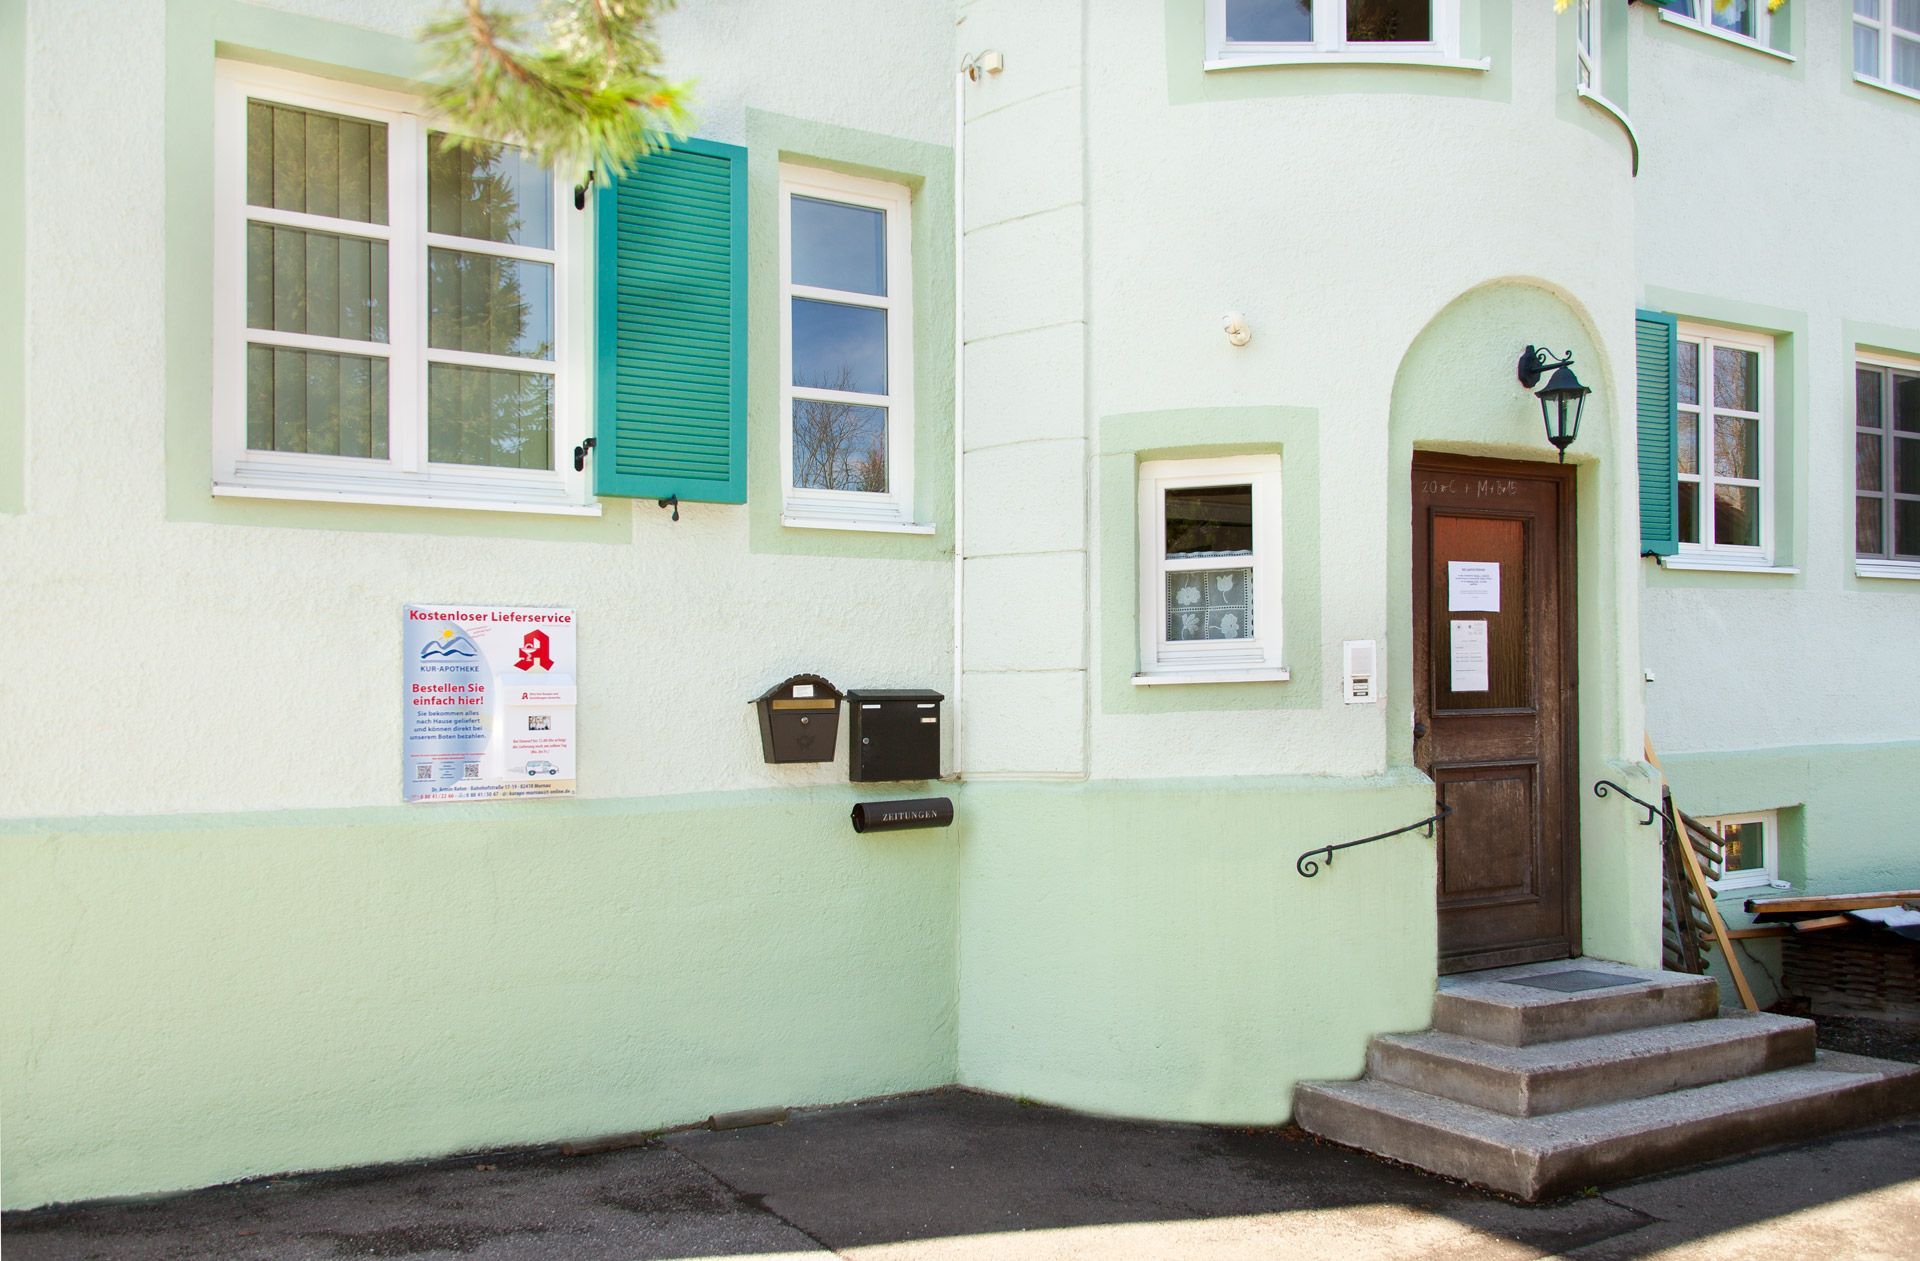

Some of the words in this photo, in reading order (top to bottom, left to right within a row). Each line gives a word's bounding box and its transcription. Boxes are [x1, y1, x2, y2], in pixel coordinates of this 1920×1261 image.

[409, 610, 488, 622] Kostenloser
[491, 611, 572, 623] Lieferservice
[412, 683, 465, 693] Bestellen
[468, 683, 485, 693] Sie
[413, 695, 457, 705] einfach
[458, 695, 484, 705] hier!
[453, 717, 480, 725] geliefert
[882, 809, 938, 822] ZEITUNGEN
